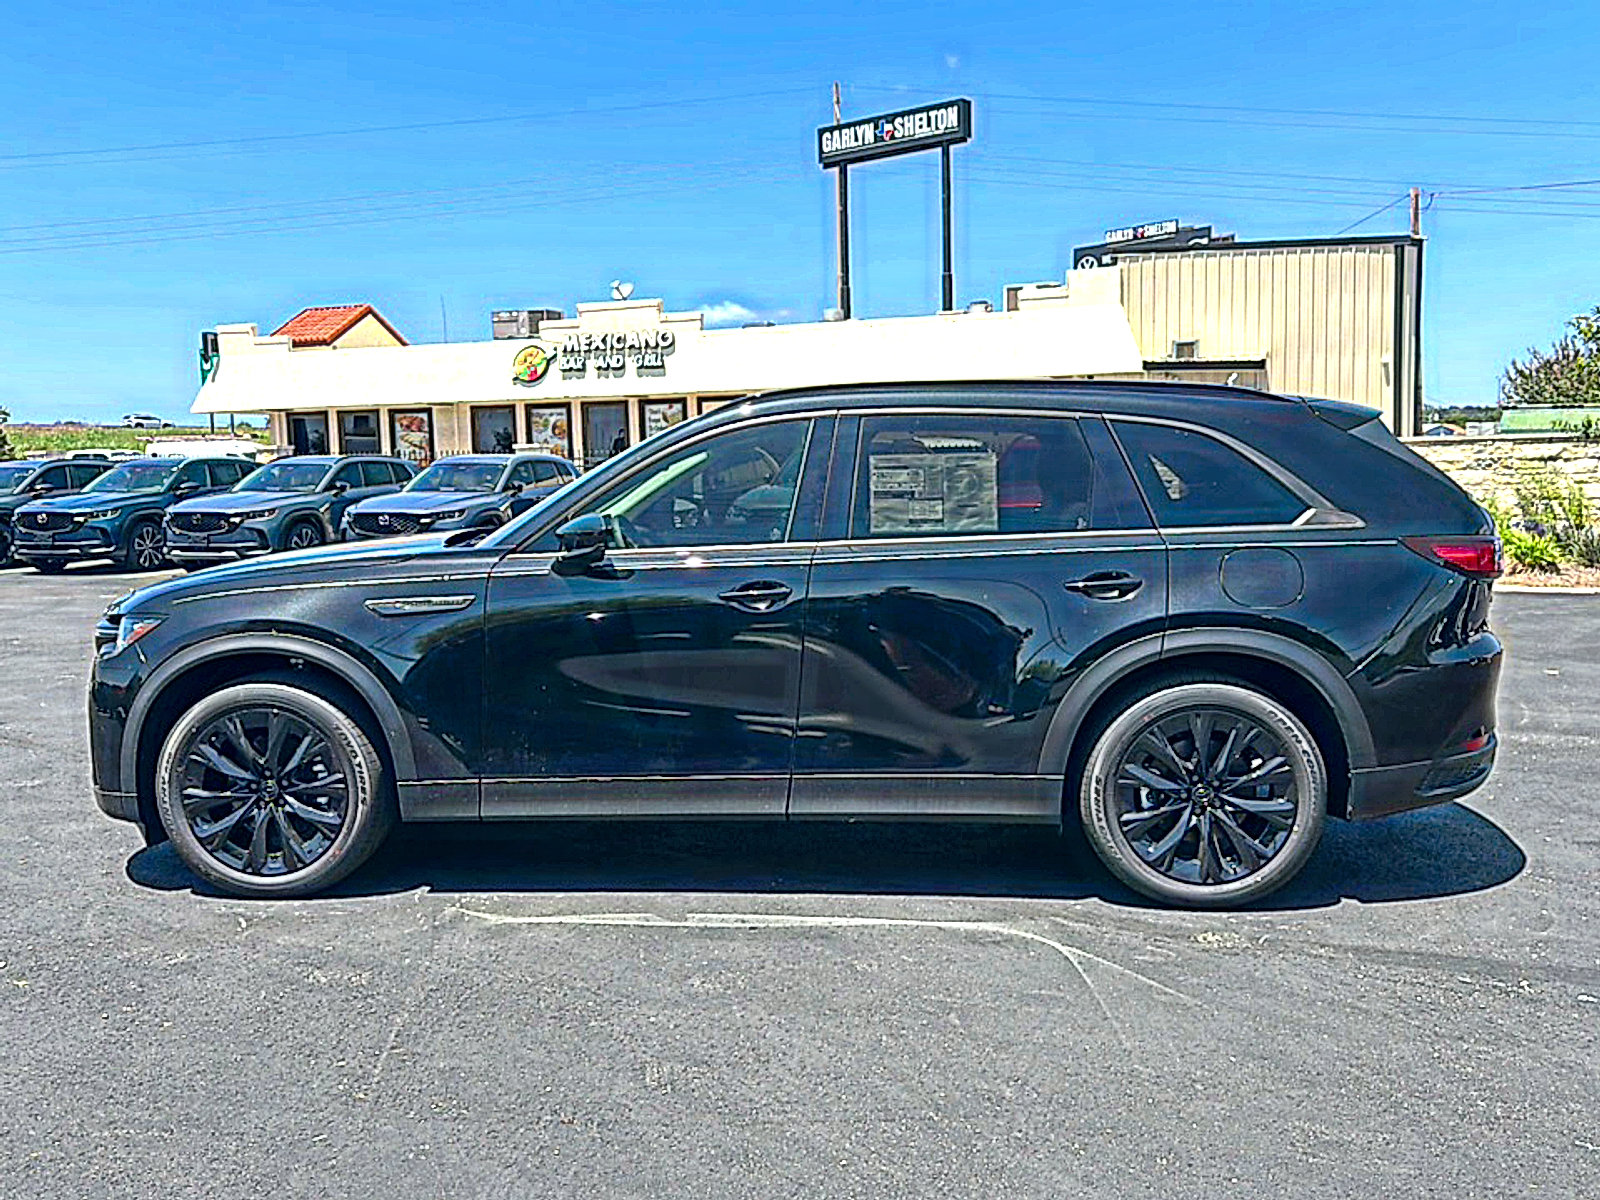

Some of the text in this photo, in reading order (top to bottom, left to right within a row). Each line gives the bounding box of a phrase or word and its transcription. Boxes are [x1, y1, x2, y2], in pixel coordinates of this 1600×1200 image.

[822, 105, 959, 152] GARLYN SHELTON
[562, 330, 674, 352] MEXICANO
[559, 356, 585, 371] BAR
[595, 354, 625, 370] AND
[354, 760, 369, 807] TIRES
